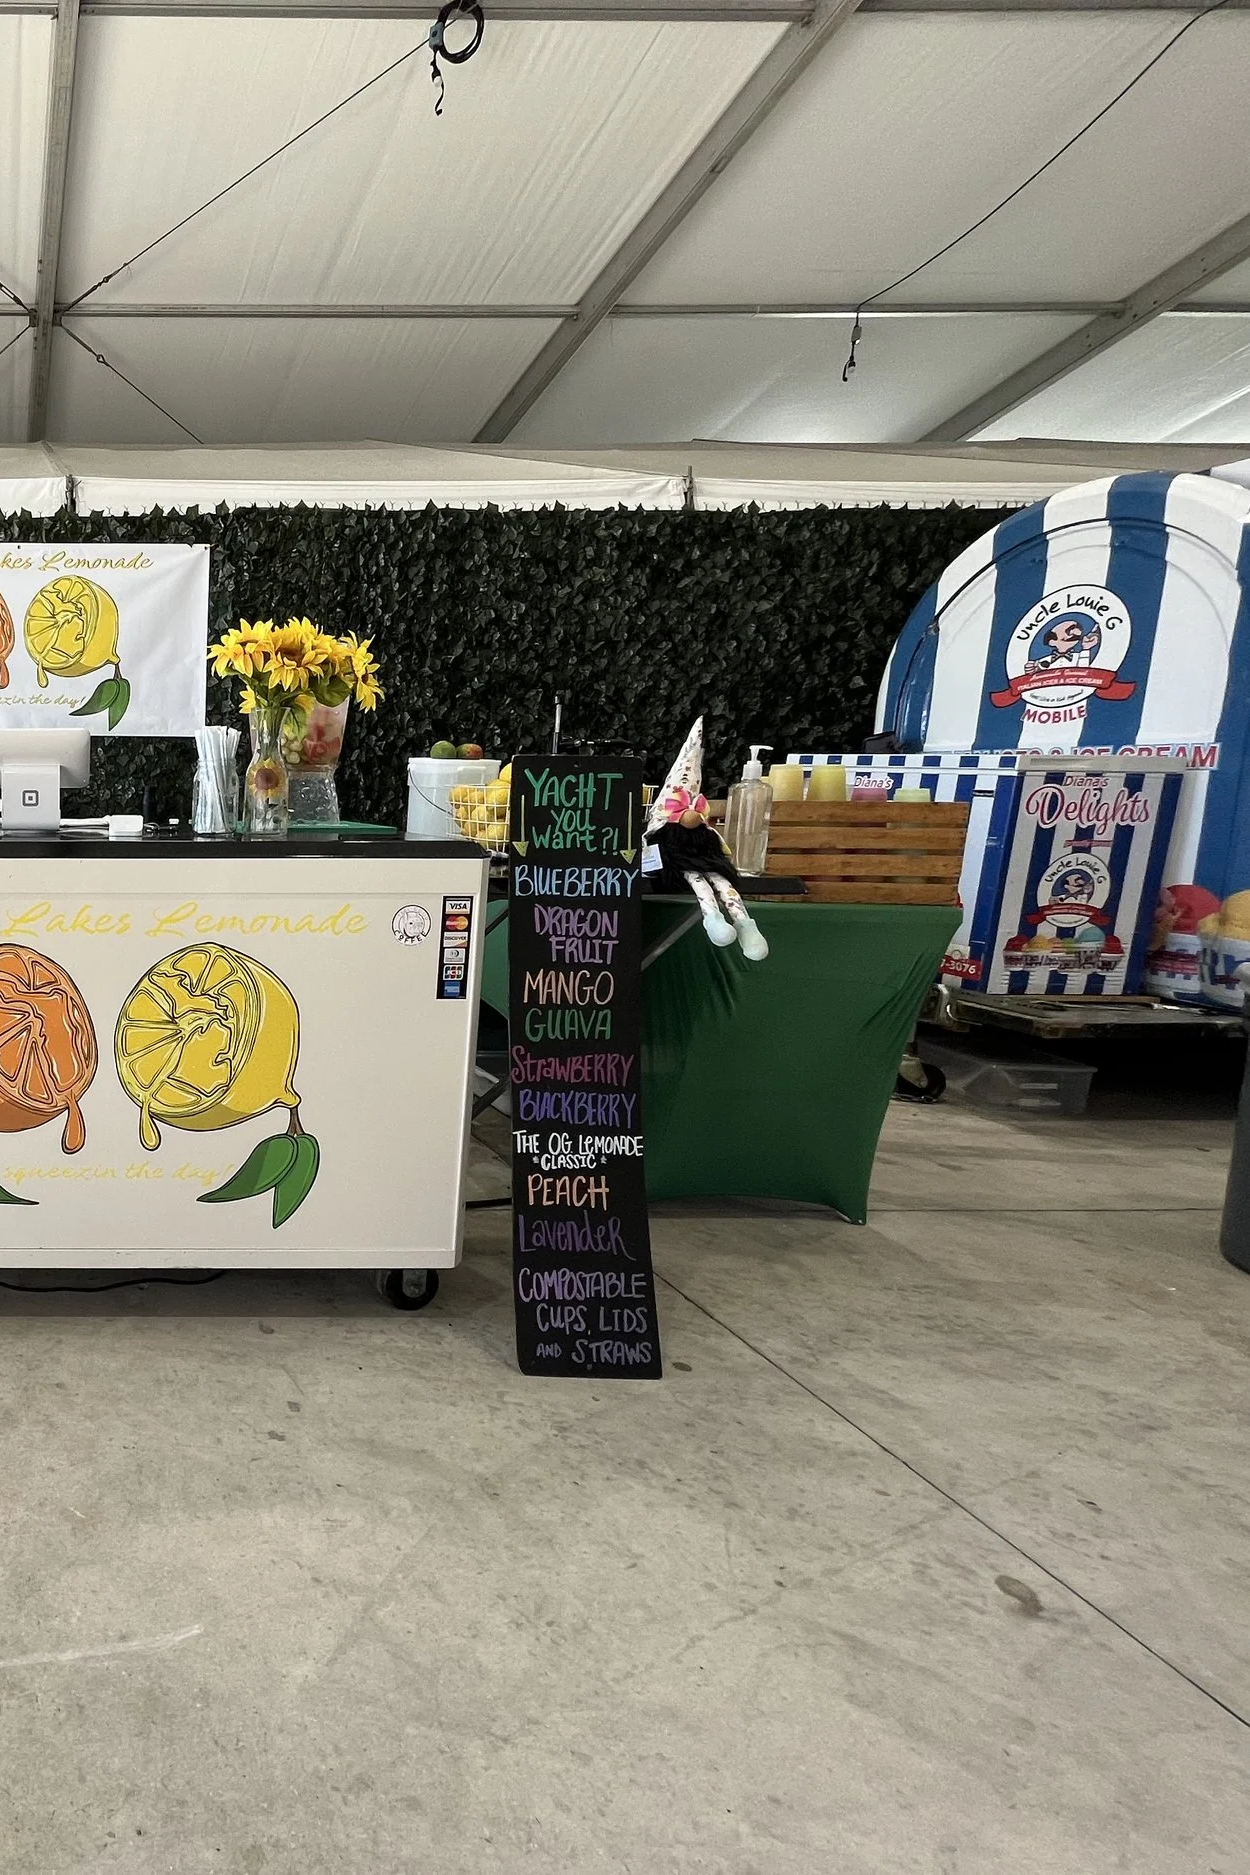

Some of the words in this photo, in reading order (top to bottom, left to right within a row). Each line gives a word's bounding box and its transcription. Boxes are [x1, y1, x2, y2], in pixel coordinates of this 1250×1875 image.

[38, 550, 154, 571] Lemonade
[1017, 601, 1061, 641] Uncle
[1066, 594, 1110, 617] Louie
[1105, 616, 1124, 631] G
[29, 693, 51, 705] the
[54, 694, 87, 708] day!
[1023, 705, 1088, 724] MOBILE
[524, 768, 624, 811] YACHT
[854, 777, 893, 789] Diana's
[1063, 776, 1110, 788] Diana's
[1025, 784, 1151, 835] Delights
[143, 902, 368, 938] Lemonade
[449, 902, 468, 910] VISA
[534, 903, 619, 938] DRAGON
[394, 929, 427, 944] COFFEE
[549, 936, 620, 965] FRUIT
[523, 969, 615, 1006] MANGO
[525, 1008, 612, 1042] GUAVA
[512, 1130, 540, 1154] THE
[2, 1163, 118, 1185] squeezin
[125, 1160, 164, 1180] the
[171, 1160, 235, 1187] day!
[541, 1153, 597, 1171] CLASSIC
[527, 1173, 610, 1211] PEACH
[518, 1267, 647, 1302] COMPOSTABLE
[600, 1306, 648, 1334] LIDS
[536, 1342, 562, 1358] AND
[571, 1338, 652, 1366] STRAWS
